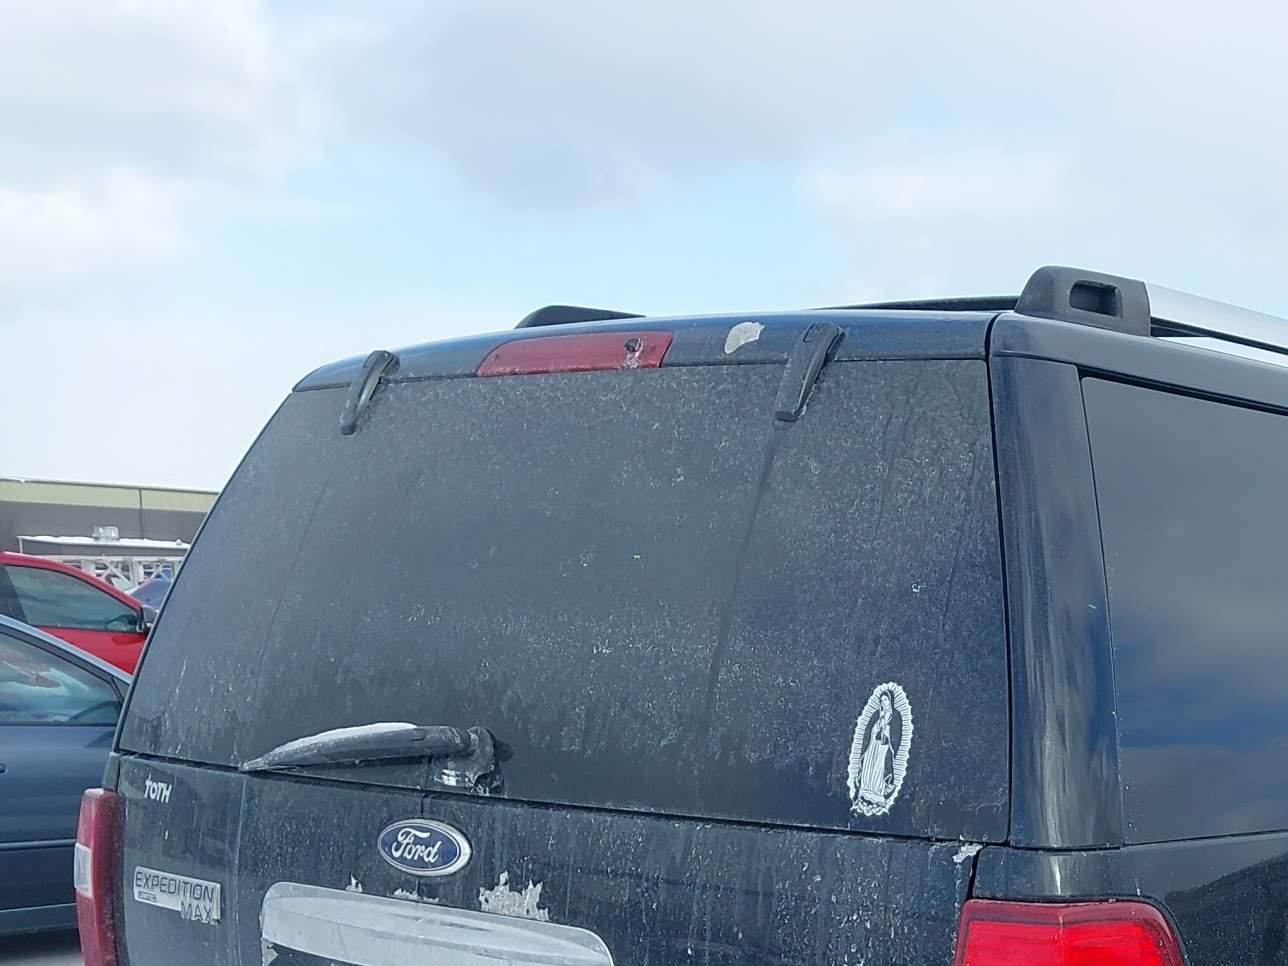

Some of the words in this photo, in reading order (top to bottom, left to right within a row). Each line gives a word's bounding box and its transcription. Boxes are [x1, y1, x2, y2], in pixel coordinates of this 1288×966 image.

[391, 827, 442, 863] Ford
[135, 870, 215, 903] EXPEDITION
[180, 900, 213, 922] MAX
